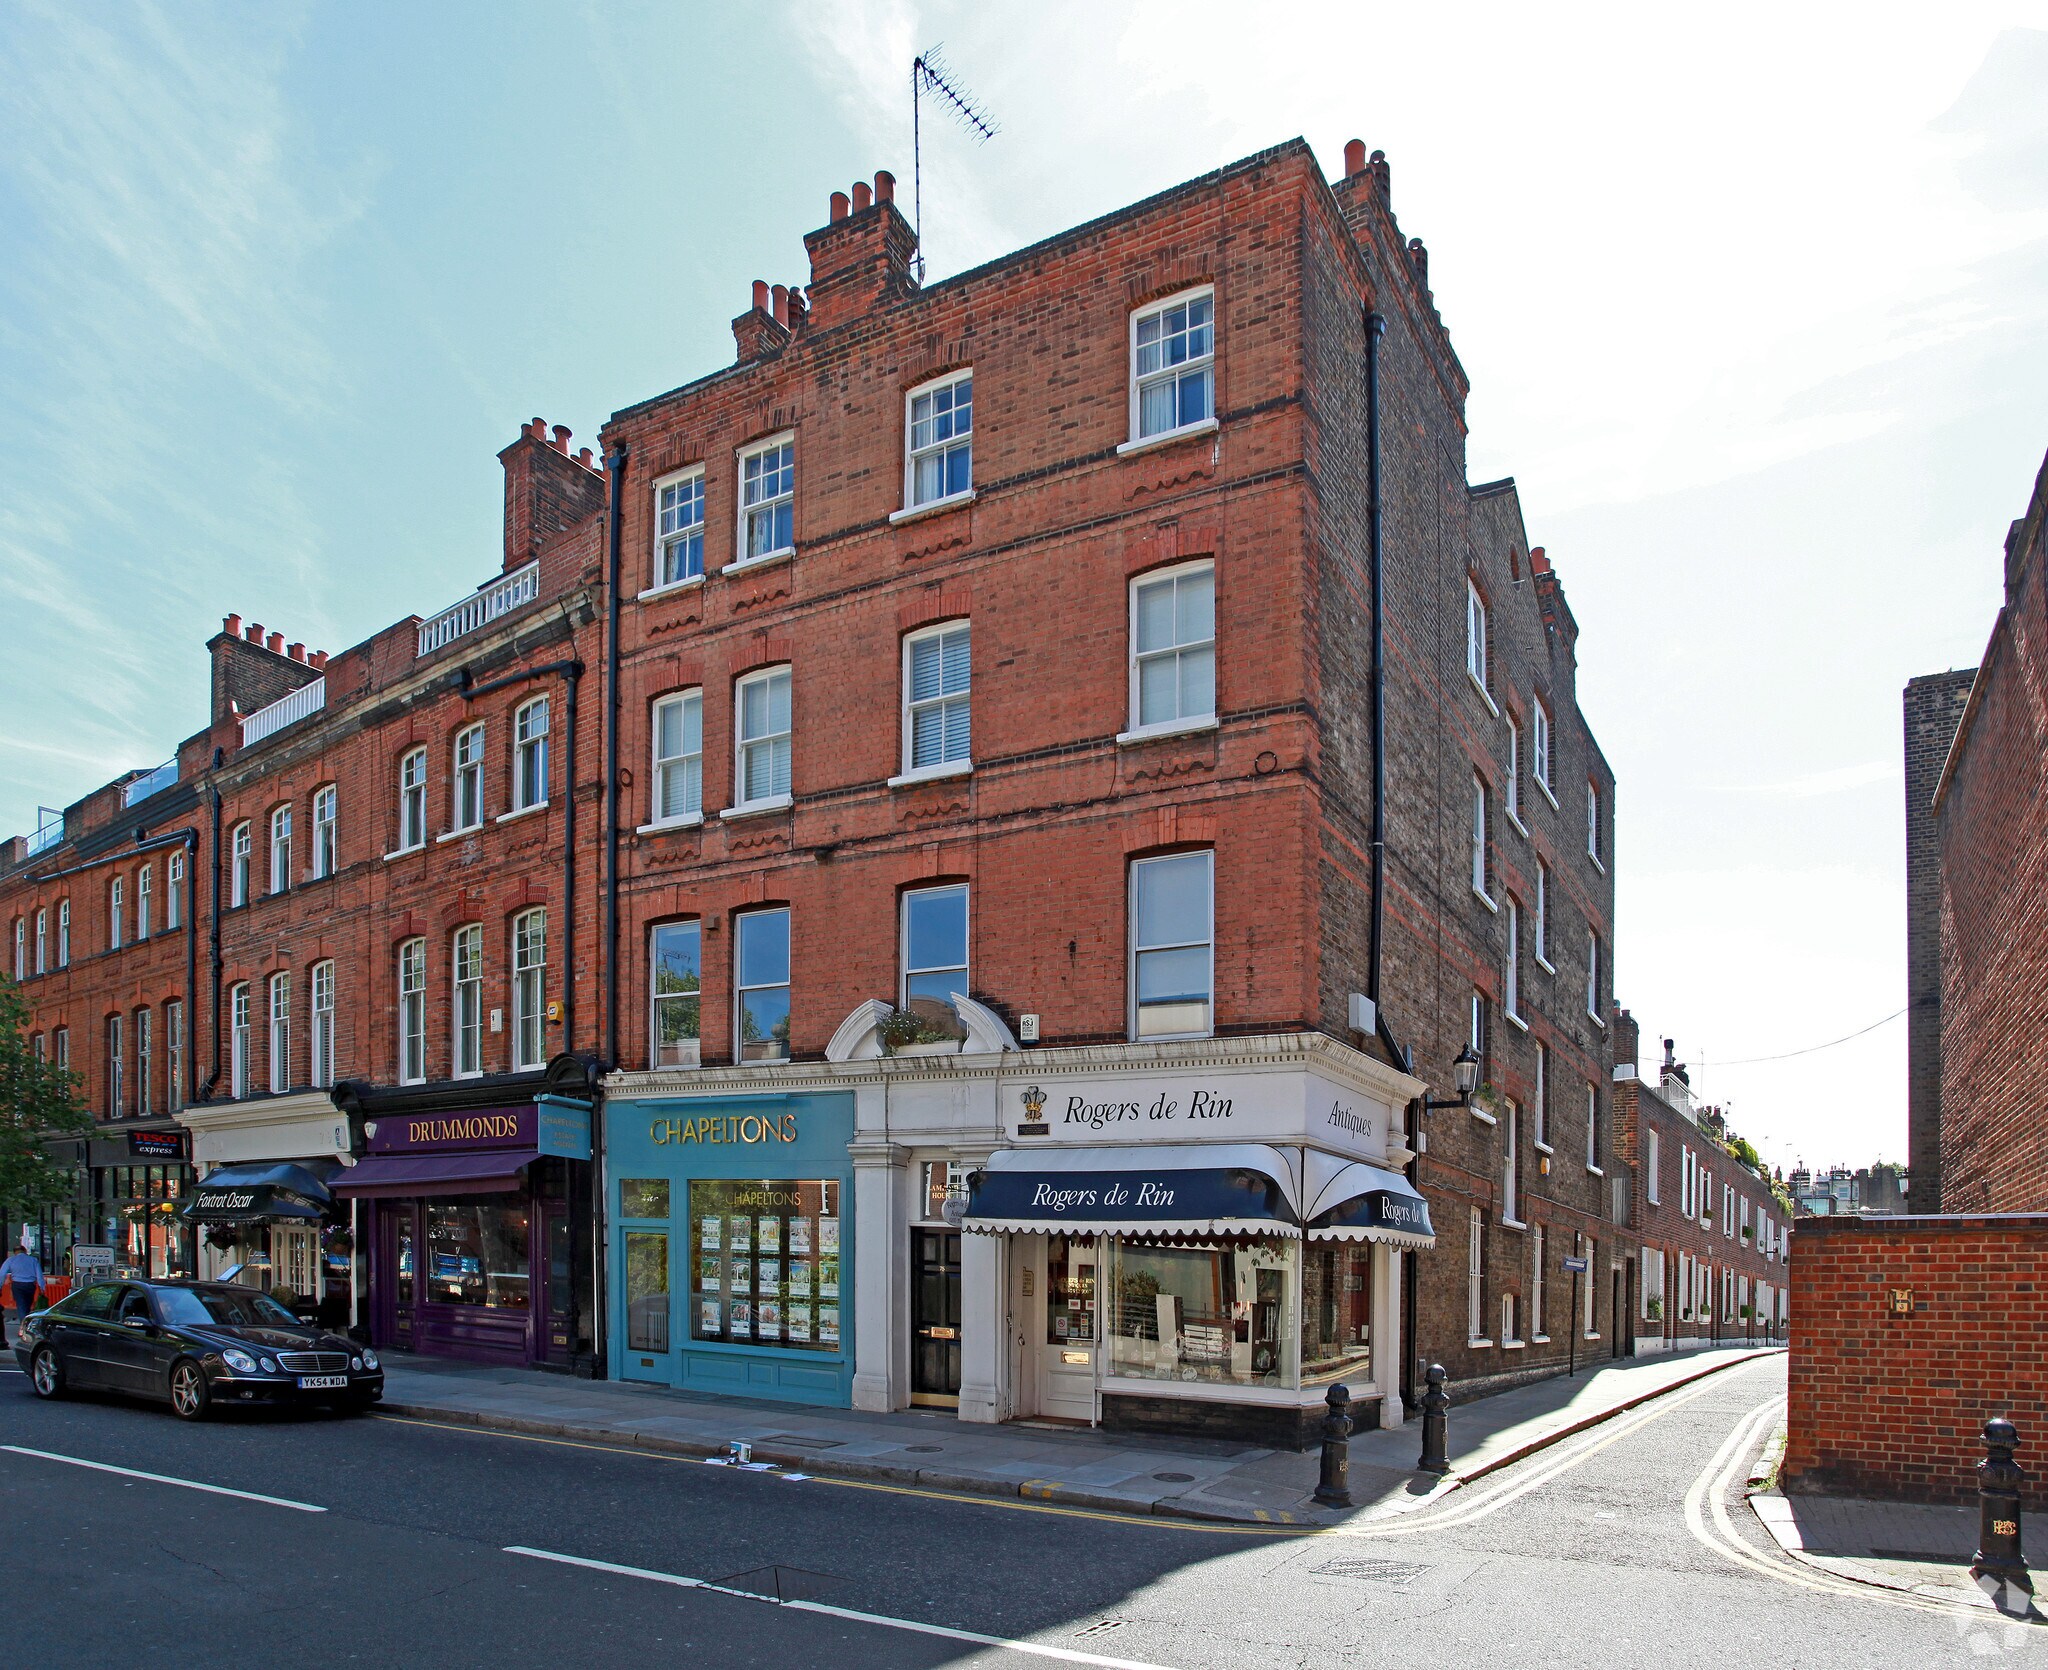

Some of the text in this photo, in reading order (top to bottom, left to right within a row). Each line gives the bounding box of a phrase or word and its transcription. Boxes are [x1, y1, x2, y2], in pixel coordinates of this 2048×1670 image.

[1063, 1090, 1233, 1130] Rogers de Rin
[1327, 1100, 1372, 1139] Antiques
[133, 1132, 178, 1143] TESCO
[409, 1115, 517, 1142] DRUMMONDS
[650, 1114, 797, 1145] CHAPELTONS
[139, 1146, 173, 1154] express
[196, 1191, 254, 1208] Foxtrot Oscar
[725, 1191, 801, 1206] CHAPELTONS
[1031, 1182, 1174, 1212] Rogers de Rin
[1381, 1196, 1410, 1226] Rogers
[304, 1377, 347, 1387] YK54 WDA
